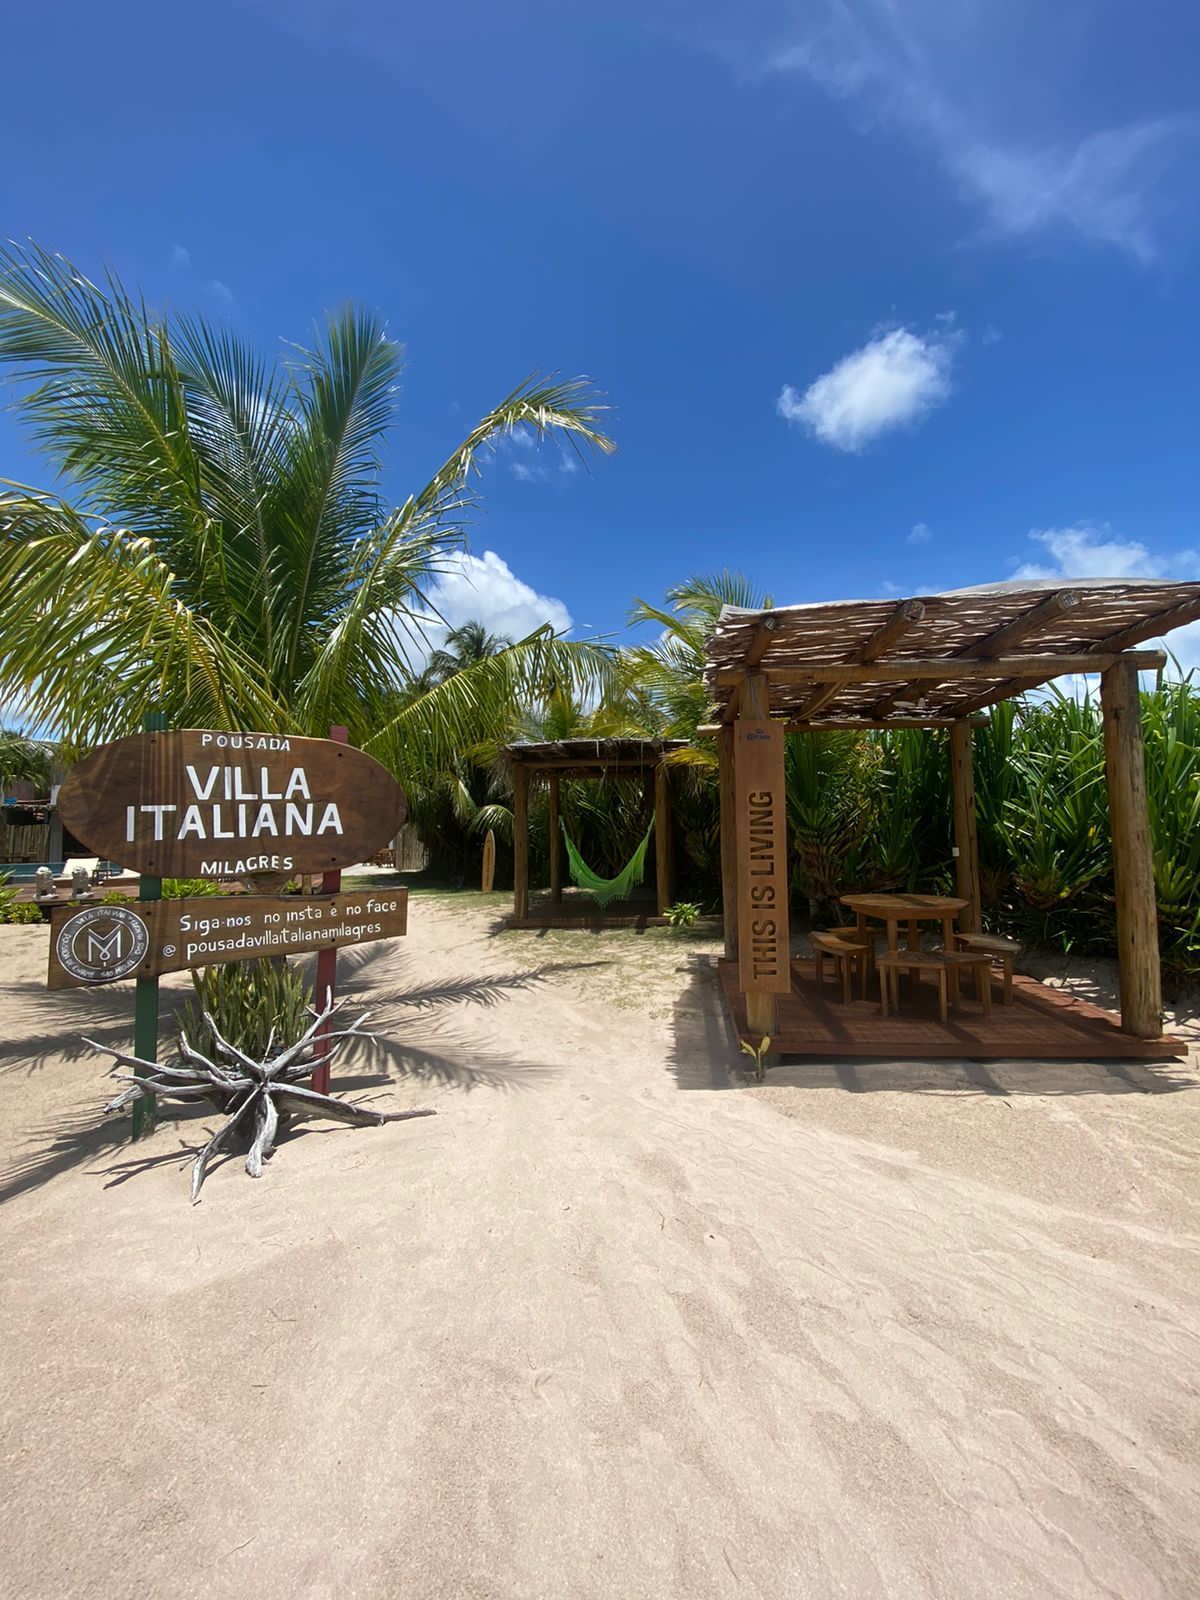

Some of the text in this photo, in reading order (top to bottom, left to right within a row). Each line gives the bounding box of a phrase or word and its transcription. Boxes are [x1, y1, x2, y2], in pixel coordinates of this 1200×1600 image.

[201, 734, 292, 753] POUSADA
[185, 765, 312, 802] VILLA
[125, 803, 344, 842] ITALIANA
[200, 855, 294, 875] MILAGRES
[748, 791, 777, 979] THIS IS LIVING
[264, 912, 280, 924] no
[286, 905, 322, 923] insta
[346, 905, 362, 916] no
[366, 899, 398, 913] face
[187, 921, 382, 961] pousadavillaitalianamilagres
